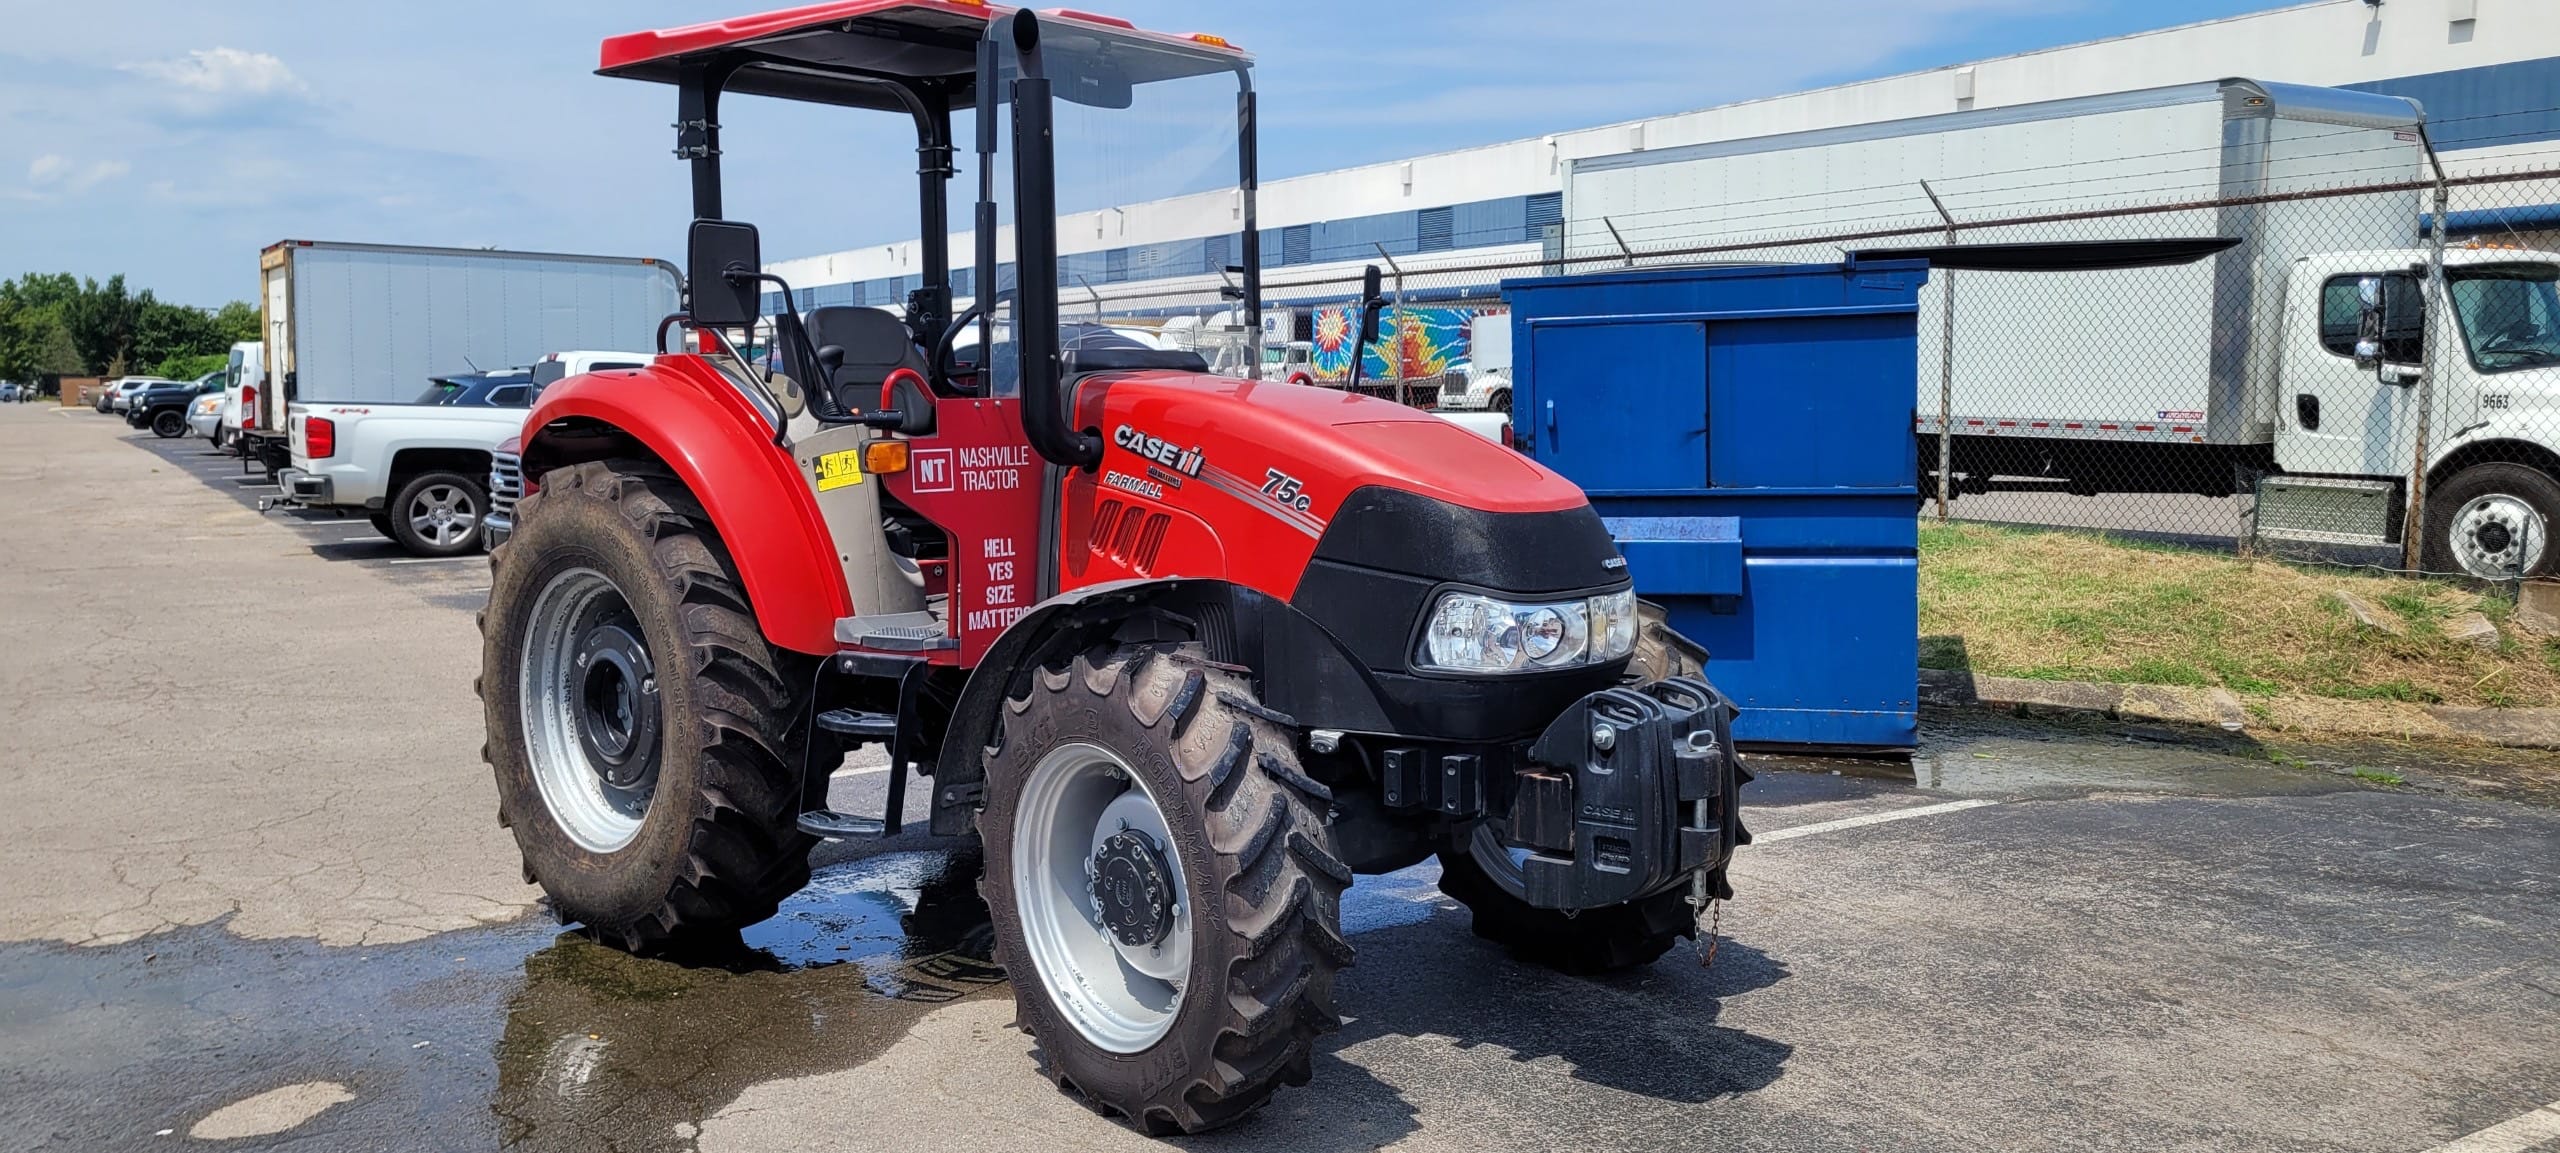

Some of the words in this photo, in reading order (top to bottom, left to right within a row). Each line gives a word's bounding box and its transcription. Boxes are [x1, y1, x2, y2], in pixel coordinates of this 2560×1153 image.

[2482, 393, 2510, 410] 9663
[959, 445, 1029, 469] NASHVILLE
[1114, 424, 1181, 467] CASE
[920, 458, 946, 483] NT
[960, 469, 1019, 492] TRACTOR
[1103, 469, 1163, 500] FARMALL
[983, 537, 1016, 559] HELL
[987, 560, 1014, 582] YES
[986, 583, 1016, 606] SIZE
[1582, 805, 1621, 819] CASE
